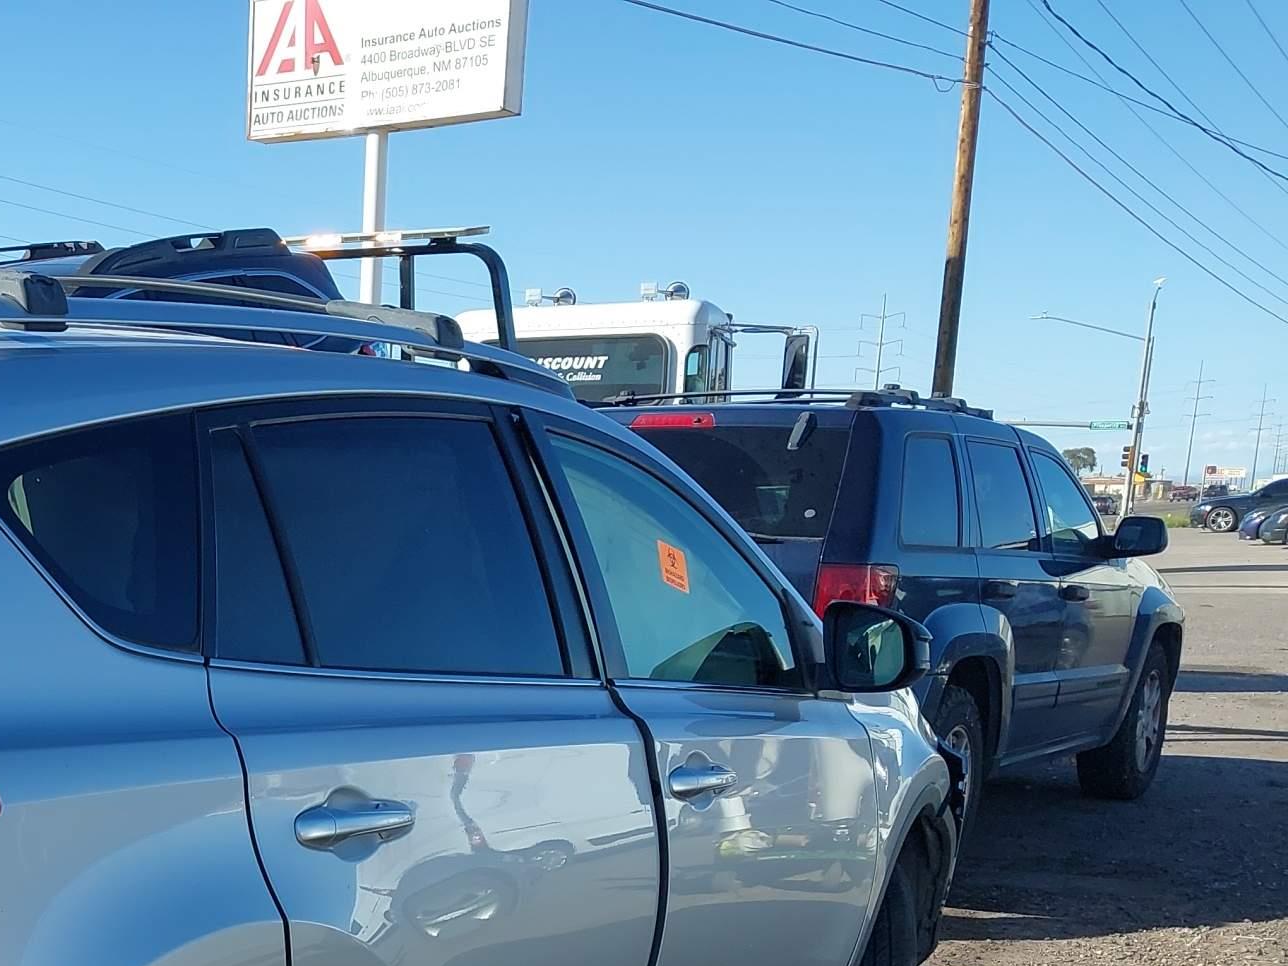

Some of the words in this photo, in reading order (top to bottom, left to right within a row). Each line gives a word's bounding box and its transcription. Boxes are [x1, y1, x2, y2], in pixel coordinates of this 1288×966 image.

[361, 31, 416, 48] Insurance
[418, 26, 446, 39] Auto
[448, 17, 502, 35] Auctions
[360, 51, 387, 65] 4400
[389, 44, 442, 62] Broadway
[445, 37, 476, 53] BLVD
[479, 34, 497, 48] SE
[433, 59, 452, 73] NM
[454, 54, 489, 70] 87105
[254, 80, 346, 104] INSURANCE
[381, 85, 409, 101] (505)
[411, 78, 461, 96] 873-2081
[253, 111, 284, 126] AUTO
[286, 104, 345, 122] AUCTIONS
[565, 371, 602, 382] Collision
